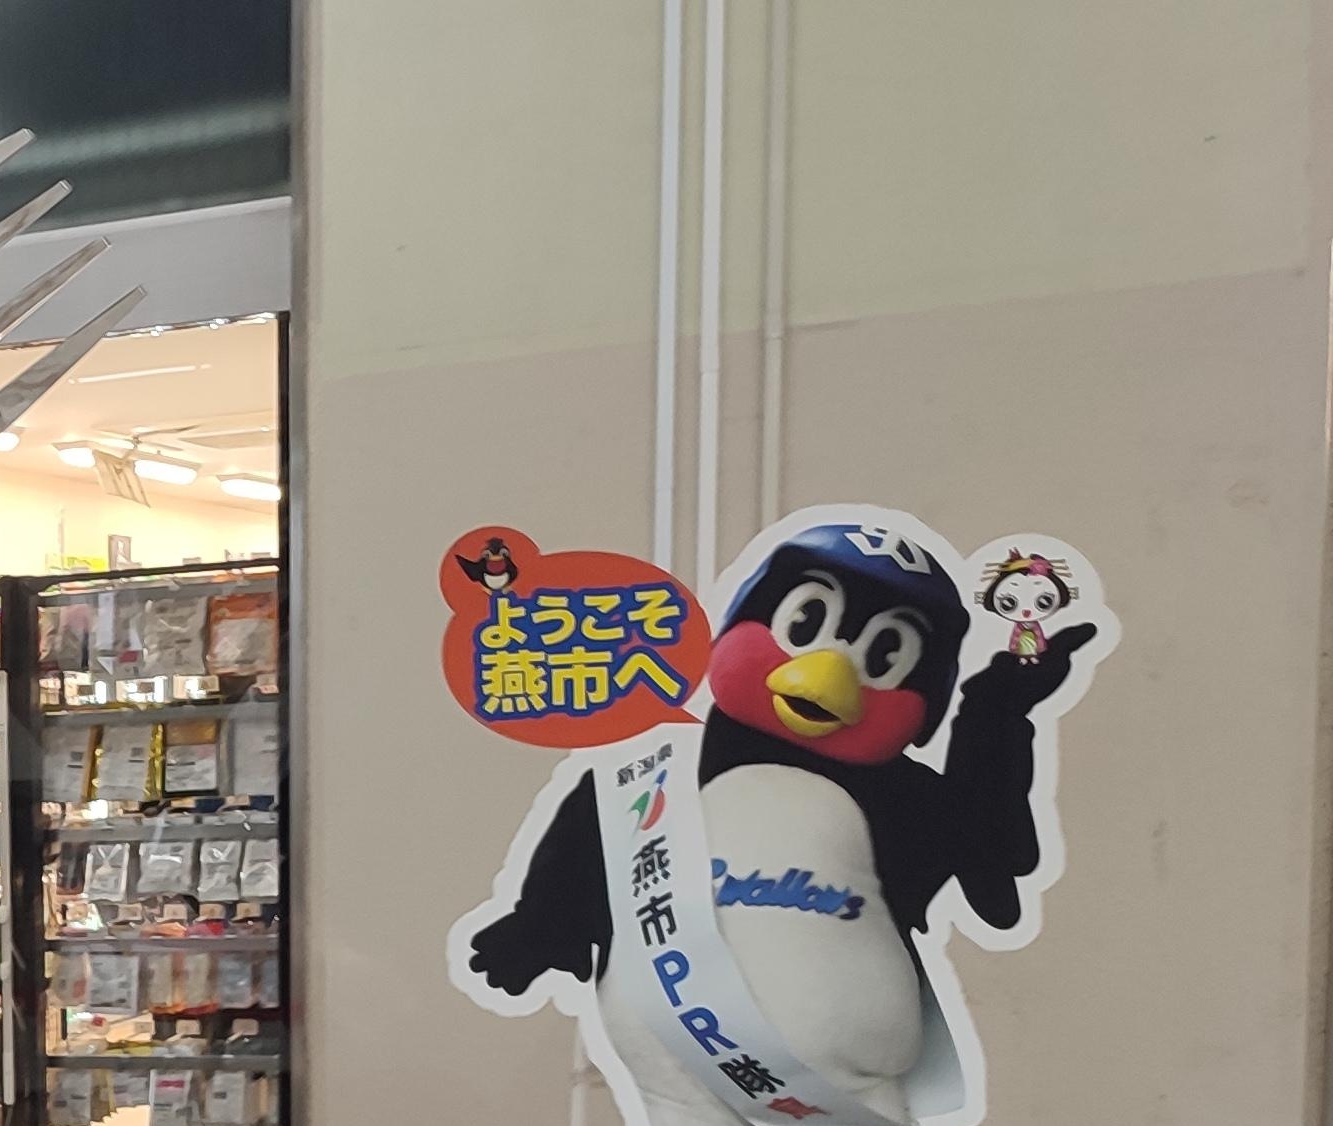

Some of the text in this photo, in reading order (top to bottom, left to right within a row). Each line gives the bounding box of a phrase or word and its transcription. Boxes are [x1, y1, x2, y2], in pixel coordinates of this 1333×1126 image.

[480, 589, 681, 648] ようこそ
[480, 647, 683, 715] 燕市へ
